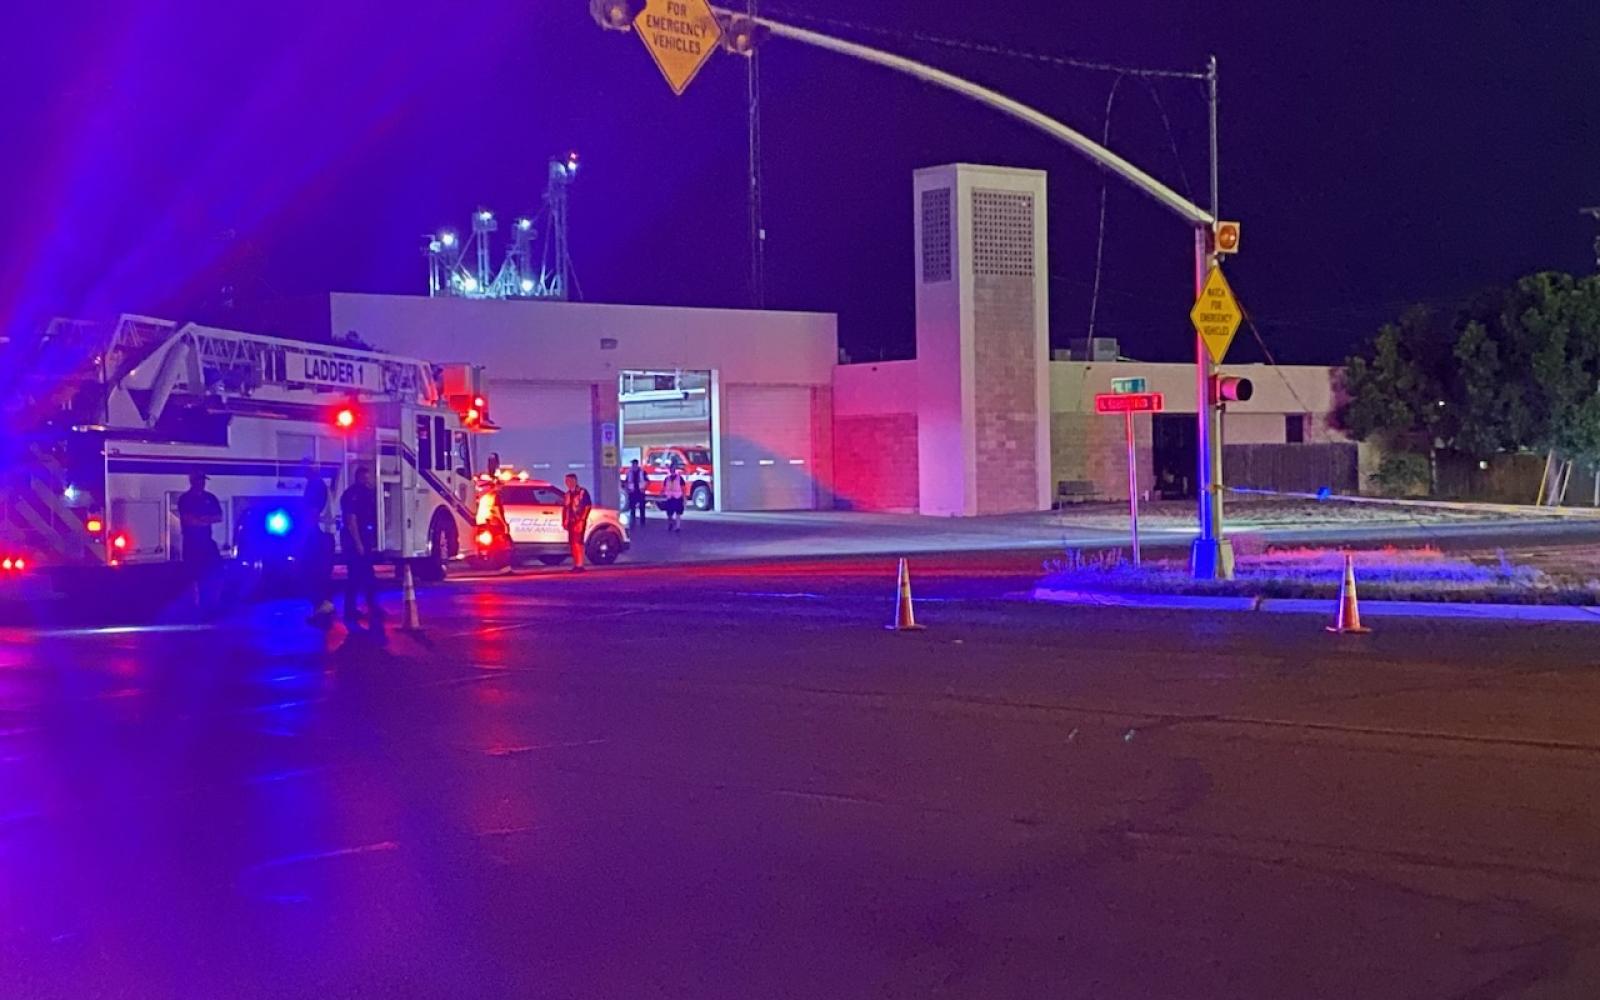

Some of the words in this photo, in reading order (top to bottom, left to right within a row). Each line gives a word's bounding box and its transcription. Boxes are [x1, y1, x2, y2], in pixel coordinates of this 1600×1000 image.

[667, 2, 686, 15] FOR
[647, 15, 708, 38] EMERGENCY
[654, 35, 700, 55] VEHICLES
[1200, 313, 1232, 323] EMERGENCY
[1203, 326, 1229, 335] VEHICLES
[305, 358, 354, 385] LADDER
[359, 364, 364, 384] 1
[509, 518, 560, 527] POLIC
